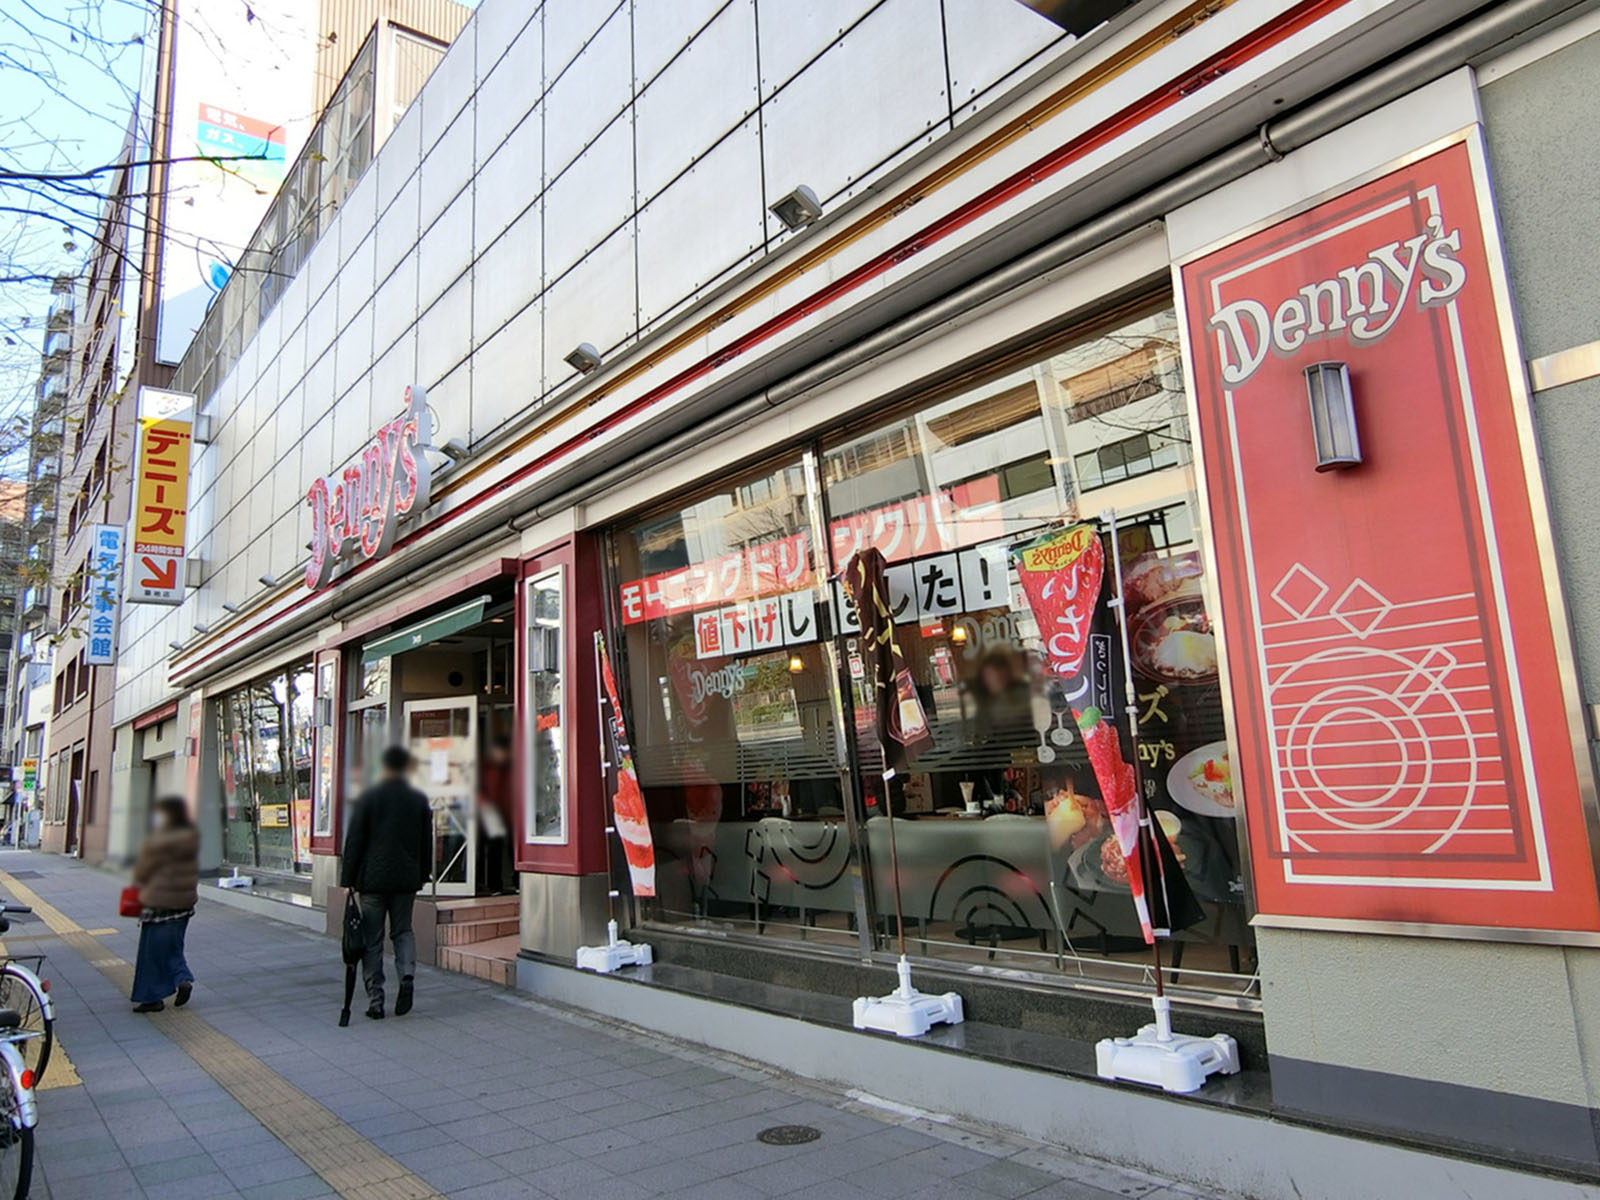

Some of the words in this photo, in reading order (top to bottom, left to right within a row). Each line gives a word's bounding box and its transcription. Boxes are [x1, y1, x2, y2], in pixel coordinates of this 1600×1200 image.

[1209, 213, 1468, 384] Denny's
[141, 428, 191, 535] デニーズ
[305, 384, 421, 590] Denny's
[90, 530, 120, 657] 電気工事会館
[690, 658, 745, 704] Denny's
